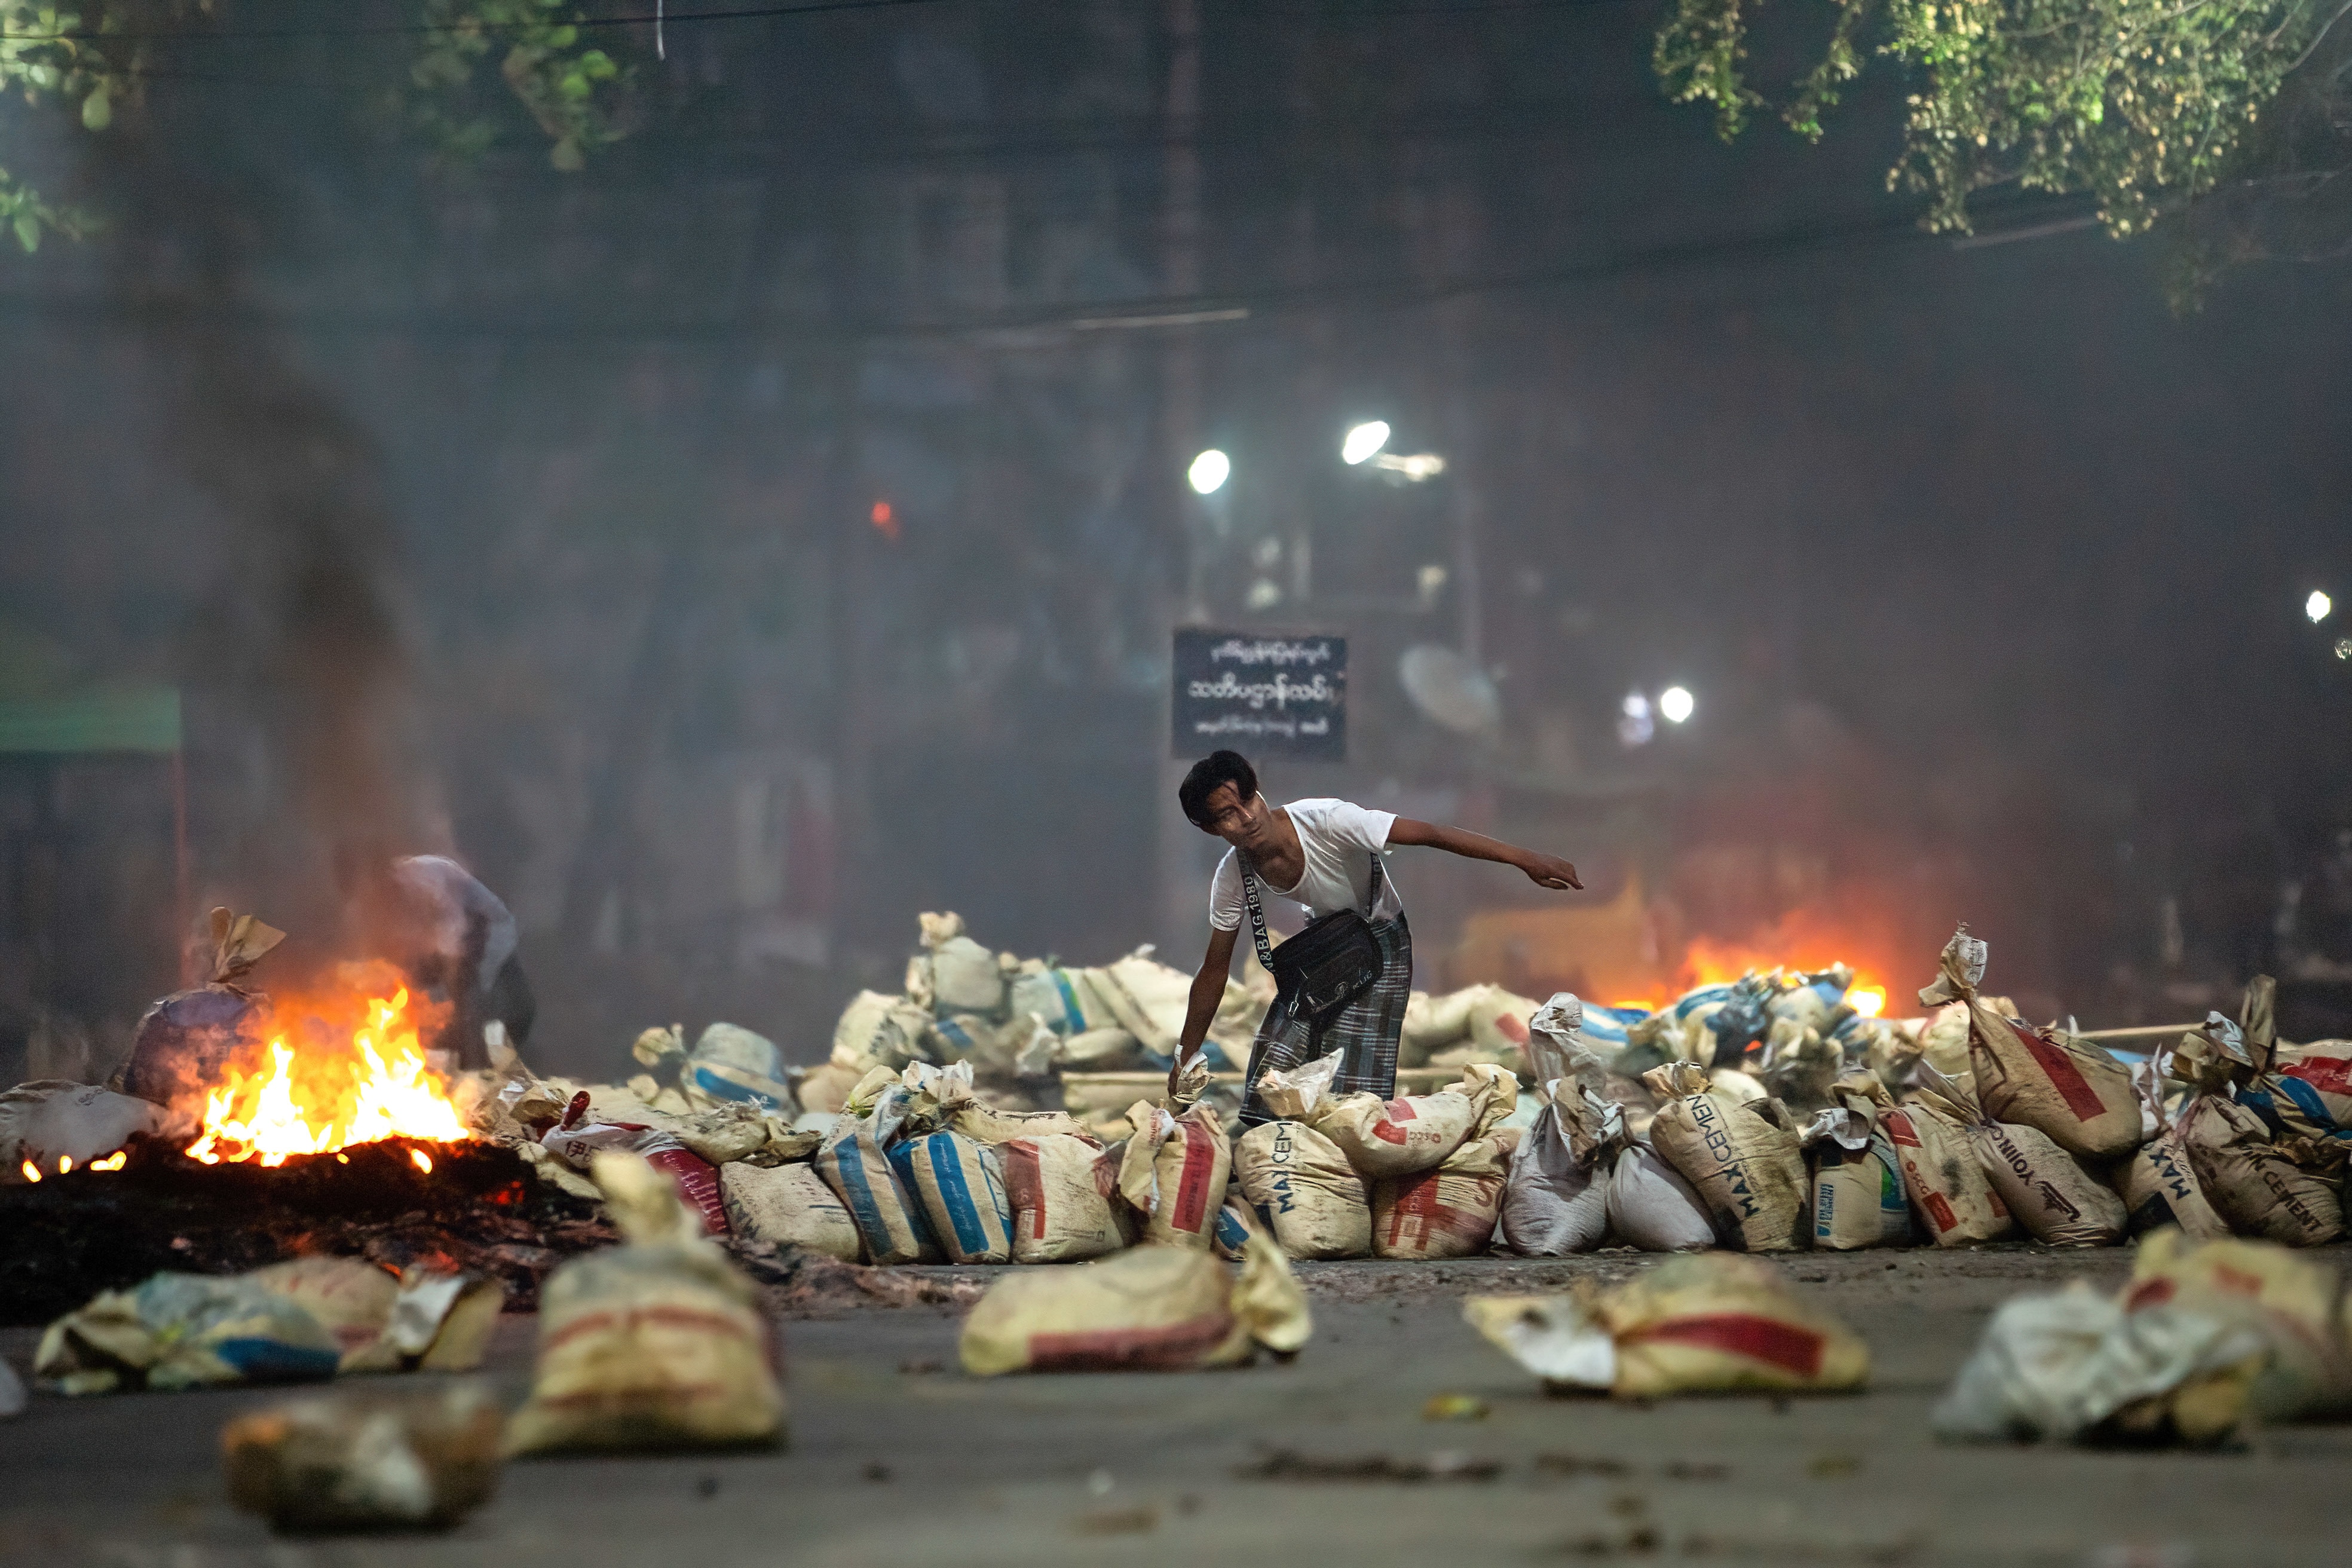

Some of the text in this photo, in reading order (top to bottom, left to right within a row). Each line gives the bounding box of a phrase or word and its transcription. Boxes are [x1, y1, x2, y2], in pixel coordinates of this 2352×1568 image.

[1724, 1169, 1760, 1218] MAX
[2148, 1147, 2192, 1200] MAX
[2262, 1170, 2323, 1232] CEMENT
